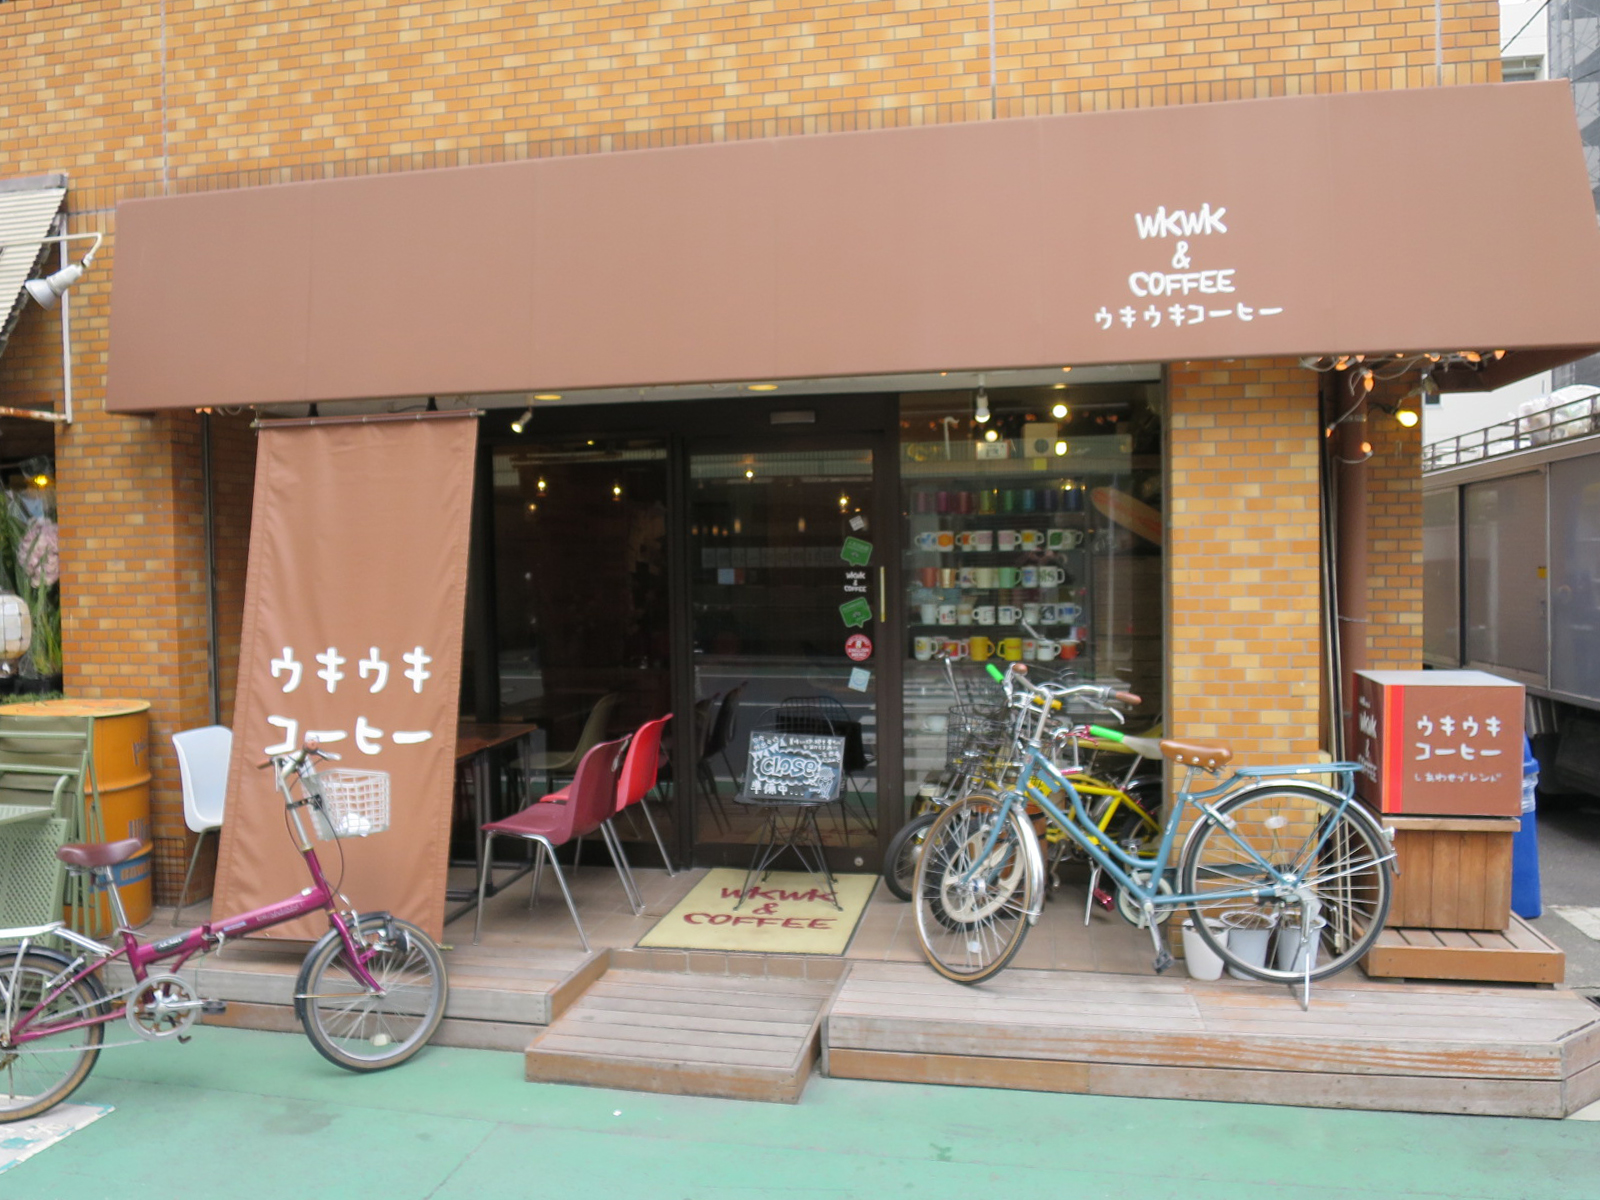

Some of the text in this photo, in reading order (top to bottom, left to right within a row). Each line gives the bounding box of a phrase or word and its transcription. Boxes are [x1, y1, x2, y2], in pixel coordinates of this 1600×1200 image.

[1135, 203, 1227, 239] WKWK
[1172, 241, 1191, 269] &
[1129, 269, 1235, 297] COFFEE
[1095, 302, 1283, 329] ウキウキコーヒー
[271, 646, 432, 693] ウキウキ
[264, 715, 433, 755] コーヒー
[1417, 715, 1501, 737] ウキウキ
[1415, 742, 1502, 760] コーヒー
[683, 912, 837, 930] COFFEE
[752, 902, 779, 915] &
